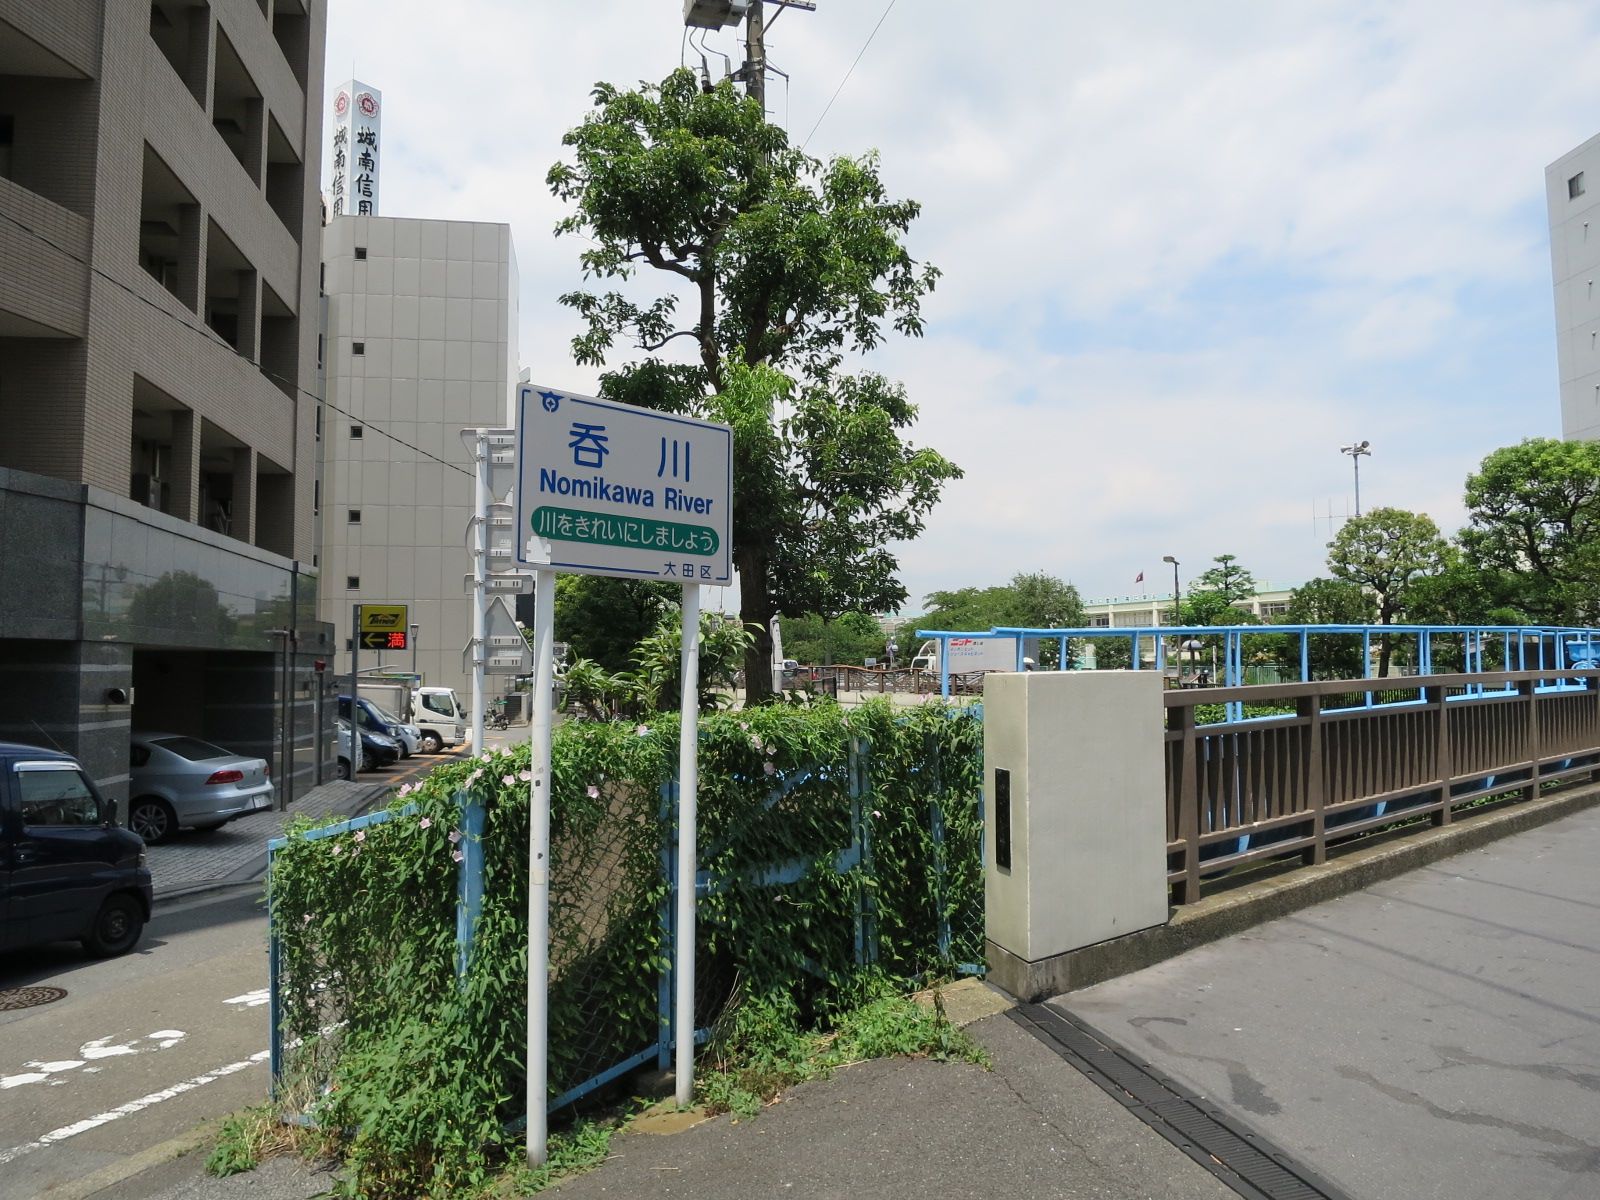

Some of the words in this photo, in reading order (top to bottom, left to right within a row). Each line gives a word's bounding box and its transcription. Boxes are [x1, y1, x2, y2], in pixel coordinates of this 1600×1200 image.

[355, 126, 377, 216] 城南信用
[539, 468, 654, 507] Nomikawa
[664, 487, 713, 515] River
[664, 561, 711, 579] 大田区
[387, 632, 405, 648] 満
